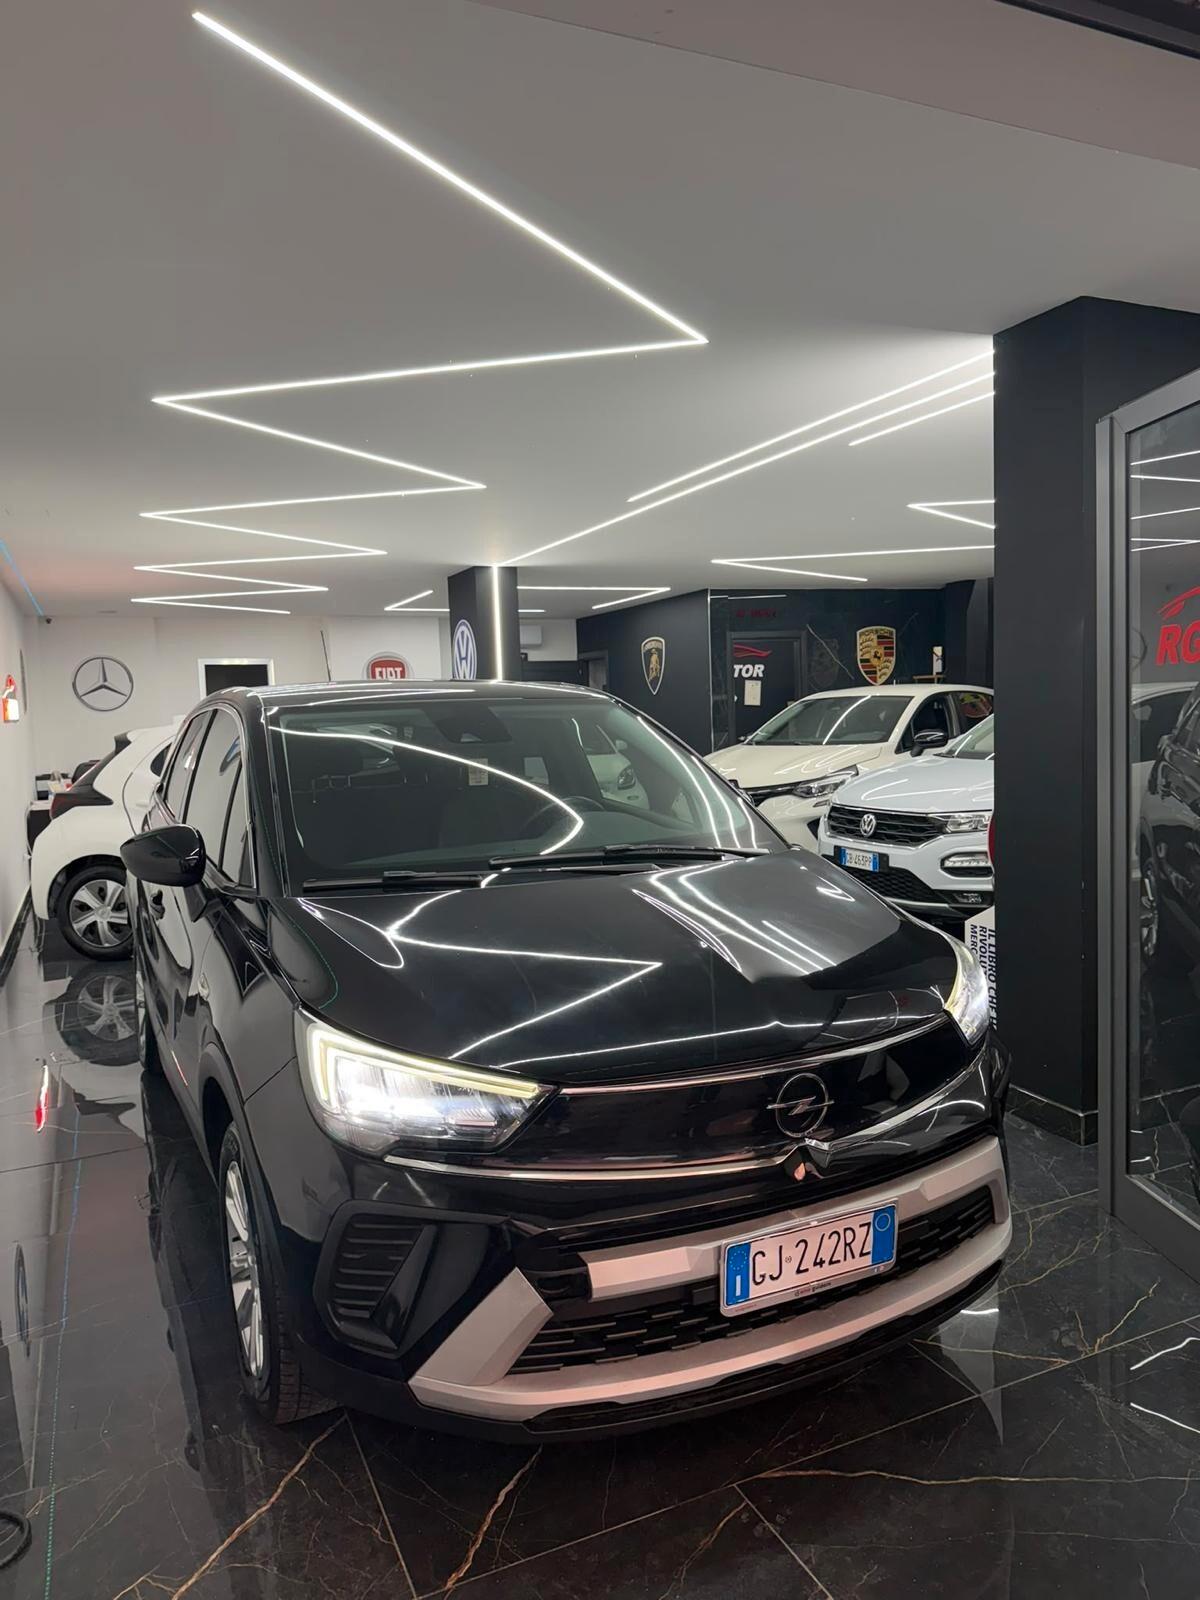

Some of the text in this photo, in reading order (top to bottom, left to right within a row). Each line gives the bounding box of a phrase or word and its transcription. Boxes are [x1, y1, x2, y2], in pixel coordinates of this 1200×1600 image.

[375, 667, 403, 680] FIAT
[733, 664, 765, 678] TOR
[988, 930, 996, 940] IL
[988, 943, 996, 983] LIBRO
